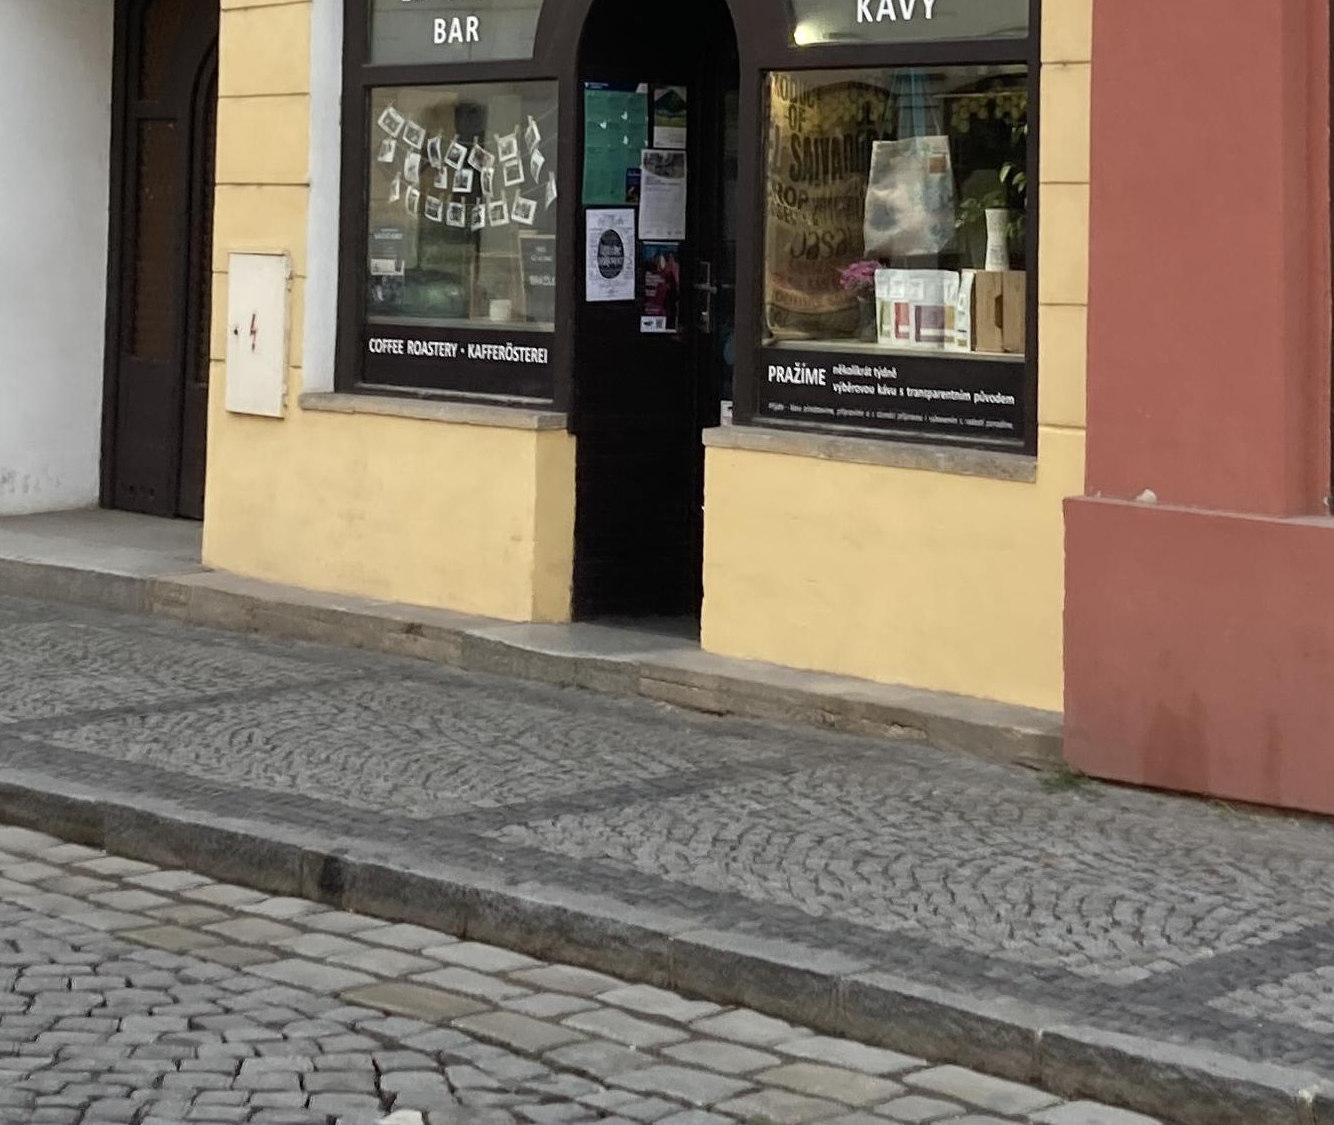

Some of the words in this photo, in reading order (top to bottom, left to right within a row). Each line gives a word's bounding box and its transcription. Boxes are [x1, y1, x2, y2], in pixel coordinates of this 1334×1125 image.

[433, 15, 480, 45] BAR
[368, 337, 404, 354] COFFEE
[406, 339, 458, 358] ROASTERY
[467, 341, 548, 364] KAFFERÖSTEREI
[768, 362, 827, 386] PRAŽÍME
